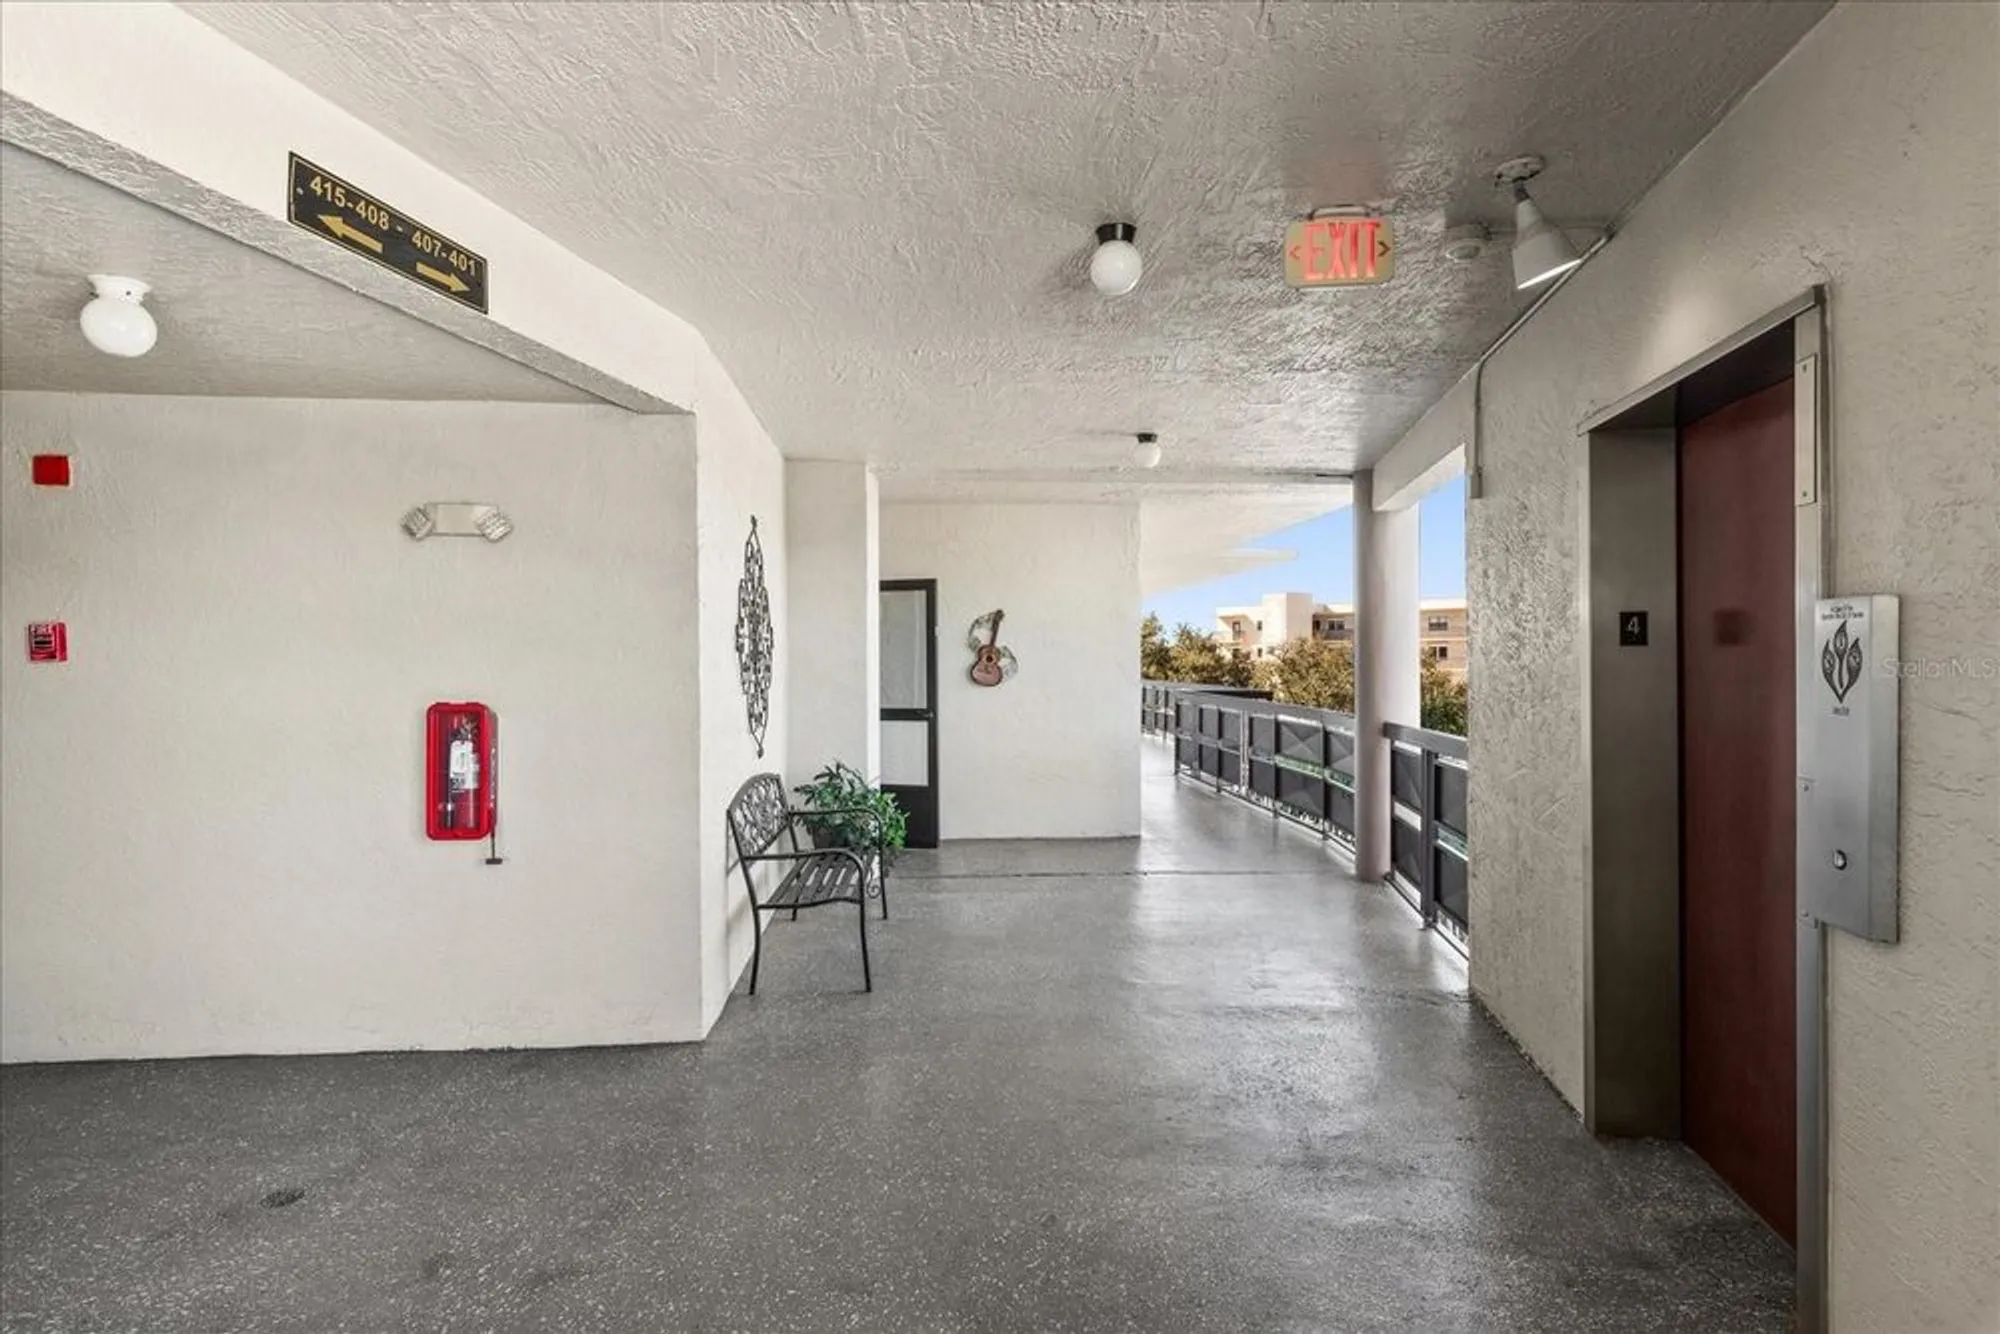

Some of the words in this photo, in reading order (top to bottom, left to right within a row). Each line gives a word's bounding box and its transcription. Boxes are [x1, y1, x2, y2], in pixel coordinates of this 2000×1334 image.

[310, 175, 389, 231] 415-408
[411, 230, 476, 277] 407-401
[1304, 222, 1380, 280] EXIT
